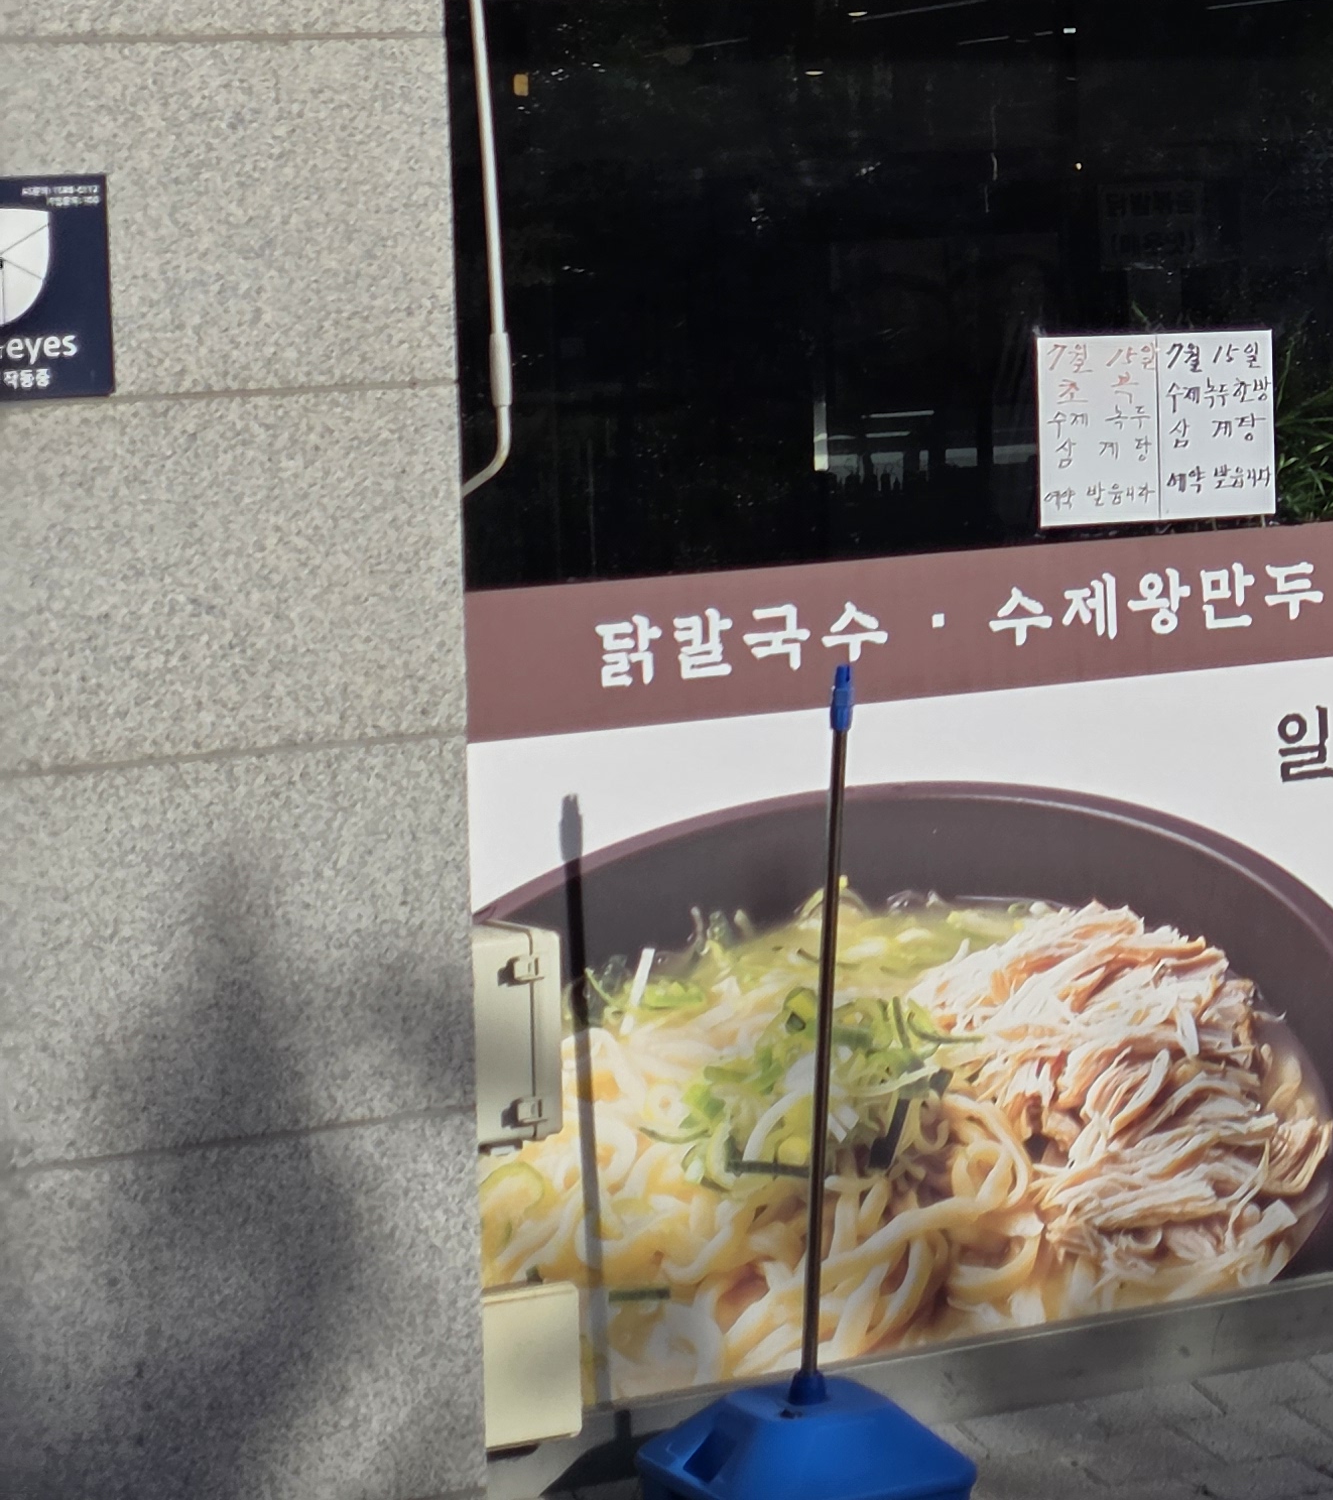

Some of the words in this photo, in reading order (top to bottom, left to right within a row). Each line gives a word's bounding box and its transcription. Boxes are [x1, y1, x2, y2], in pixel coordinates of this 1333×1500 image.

[0, 335, 78, 366] eyes
[595, 601, 889, 689] 닭칼국수
[988, 561, 1325, 647] 수제왕만두
